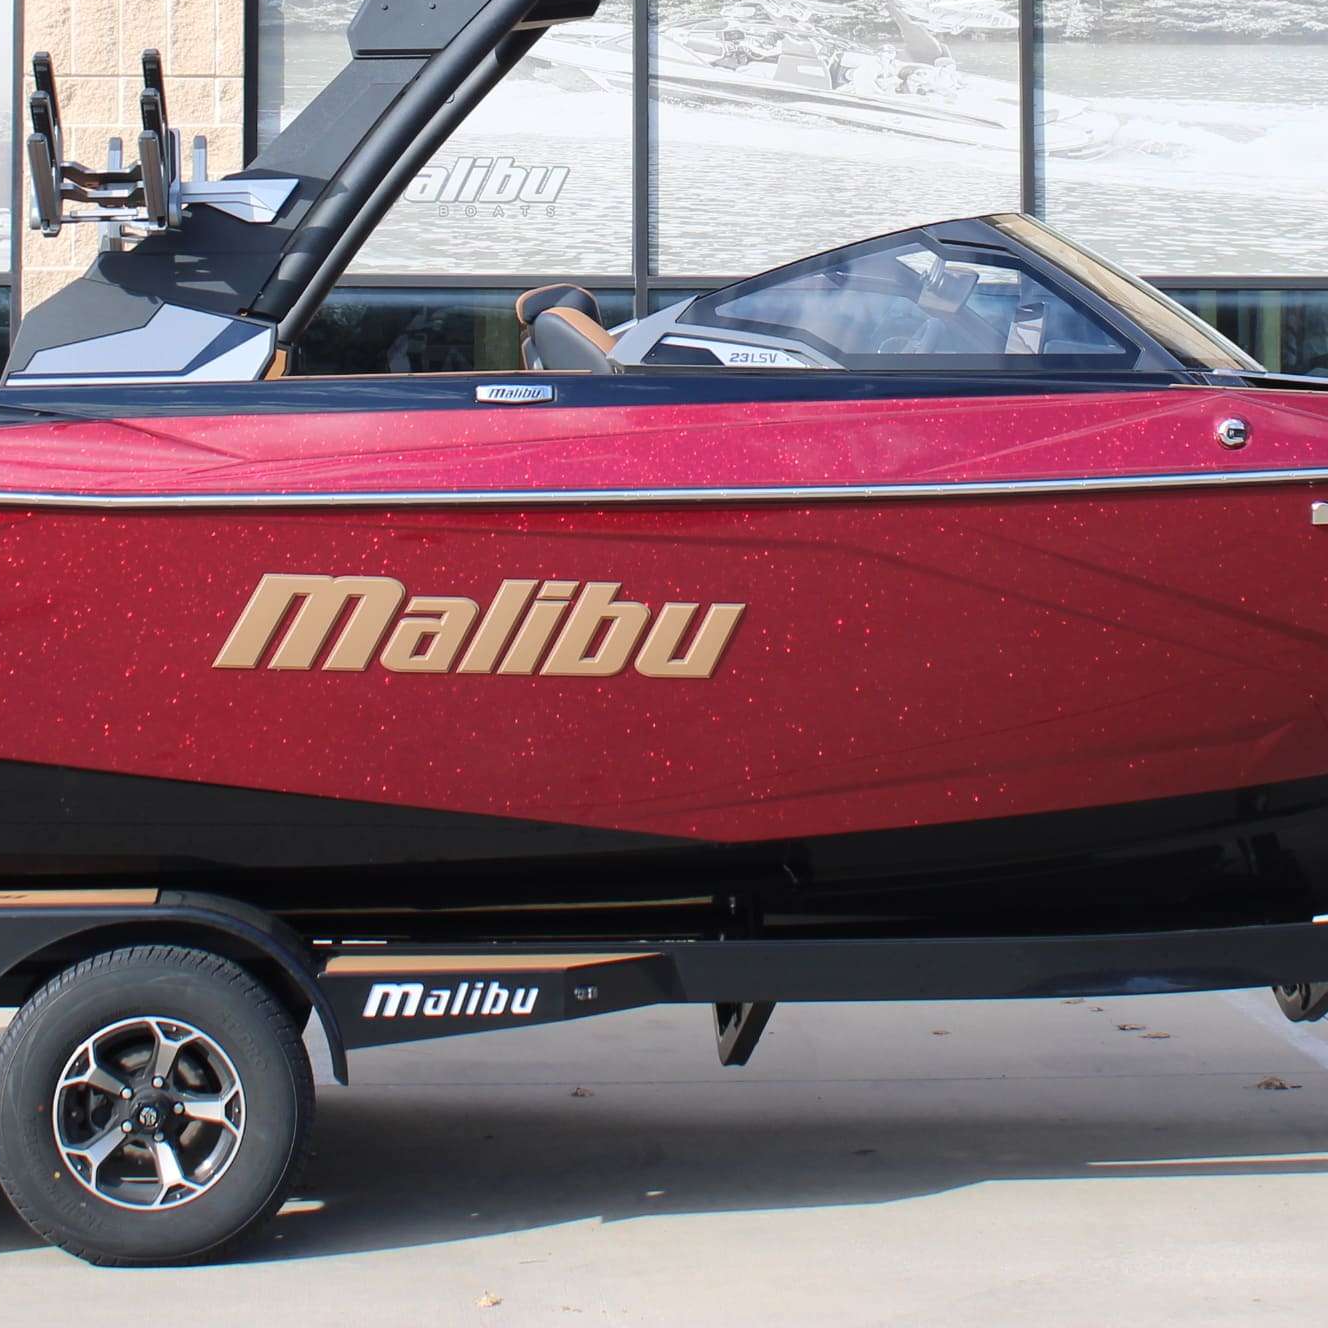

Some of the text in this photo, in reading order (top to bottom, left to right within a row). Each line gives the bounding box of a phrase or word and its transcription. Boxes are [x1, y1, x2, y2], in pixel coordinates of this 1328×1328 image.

[403, 156, 570, 204] alibu
[438, 205, 556, 218] BOATS
[729, 352, 778, 364] 23LSV
[487, 387, 542, 400] Malibu
[211, 573, 746, 678] Malibu
[362, 981, 539, 1018] Malibu
